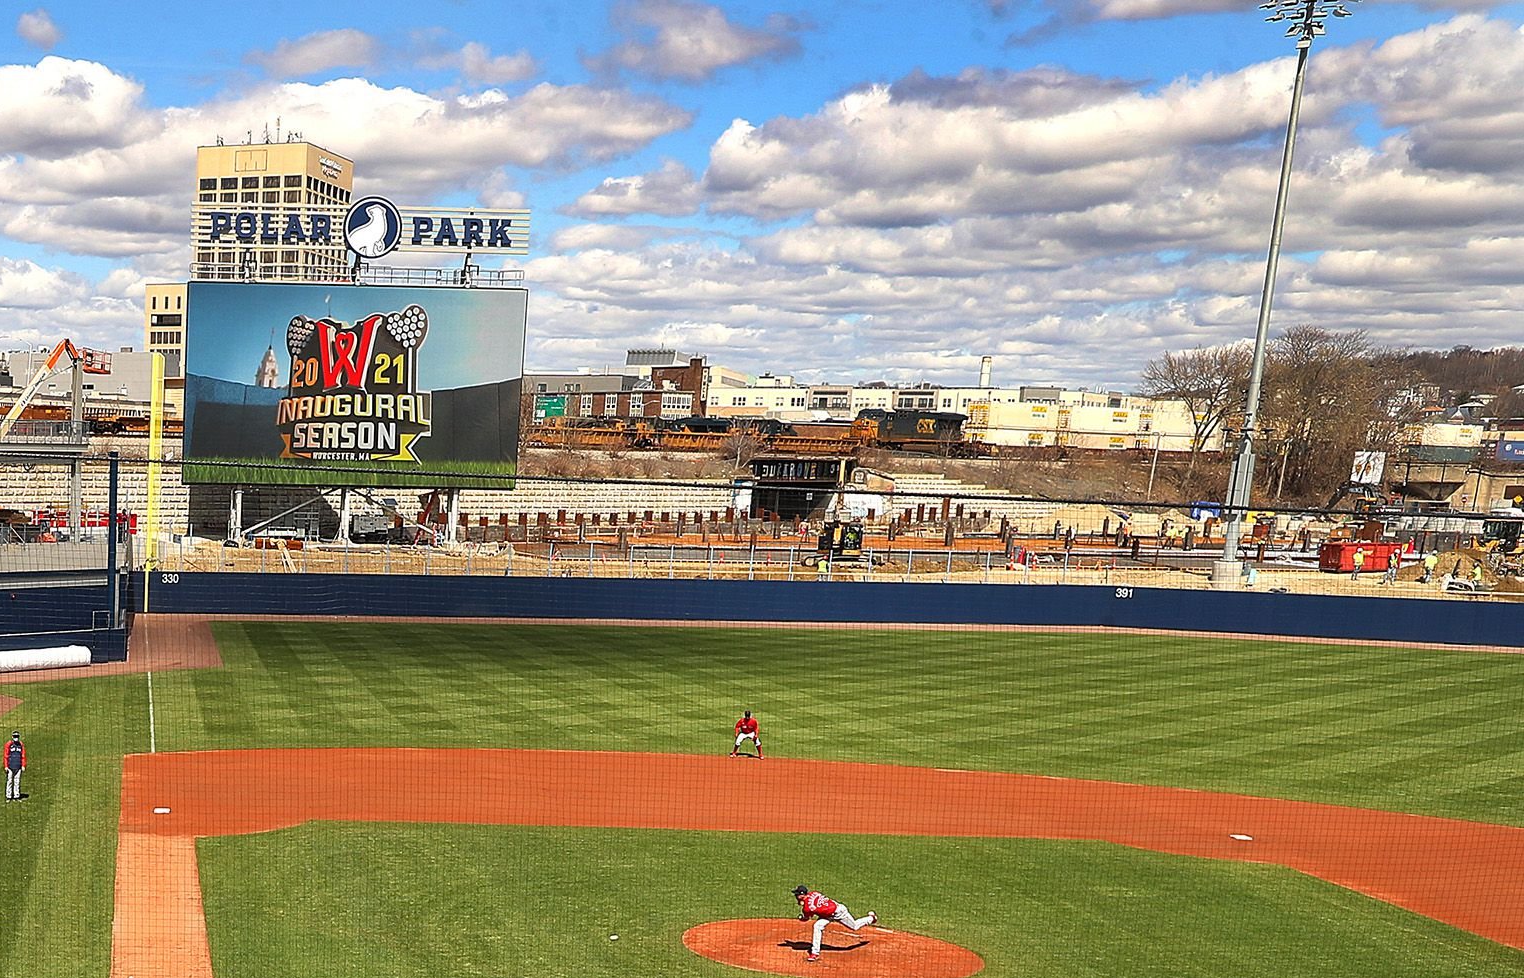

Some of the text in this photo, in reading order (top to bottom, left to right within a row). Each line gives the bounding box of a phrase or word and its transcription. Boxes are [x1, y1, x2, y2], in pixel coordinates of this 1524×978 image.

[210, 211, 512, 246] POLAR PARK
[276, 393, 431, 426] INAUGURAL
[292, 421, 397, 450] SEASON
[916, 418, 936, 434] CSX
[161, 573, 180, 584] 330
[1115, 587, 1134, 599] 391
